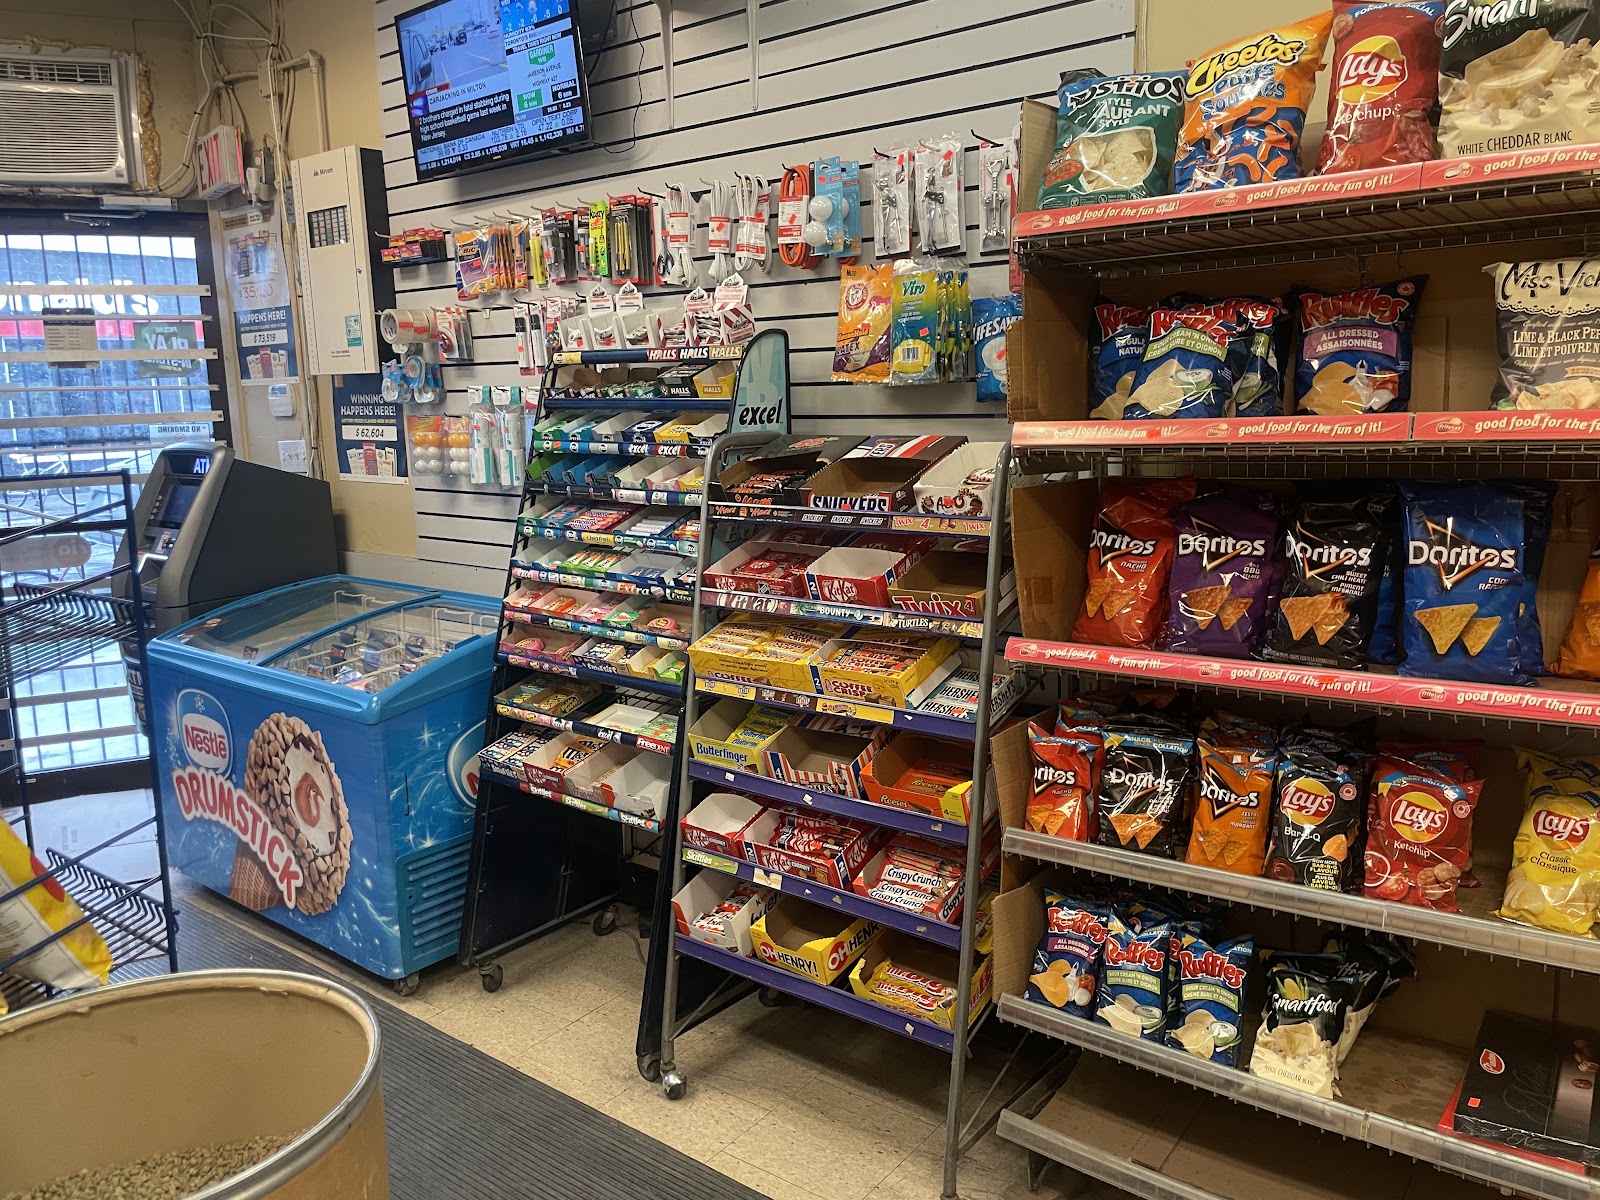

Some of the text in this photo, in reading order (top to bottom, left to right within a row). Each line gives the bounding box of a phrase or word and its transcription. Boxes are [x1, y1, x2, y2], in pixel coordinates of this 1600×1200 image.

[1185, 34, 1306, 98] Cheetos
[1339, 54, 1403, 87] Lay's
[430, 82, 486, 104] CARJACKING MILTON
[552, 80, 576, 92] NORMAL
[523, 91, 535, 100] NOW
[423, 93, 510, 124] brothers charged stabbing during
[430, 112, 479, 132] school basketball game
[464, 134, 485, 144] CANADA
[1458, 130, 1573, 155] WHITE CHEDDAR BLANC
[198, 133, 221, 191] EXIT
[1484, 150, 1598, 175] good food for the
[1247, 173, 1394, 204] good food for the fun of it!
[1059, 206, 1153, 226] good food for the fun
[1501, 263, 1556, 299] Miss
[239, 309, 286, 325] HAPPENS HERE!
[1300, 287, 1409, 332] Ruffles
[1170, 330, 1193, 341] CREAM
[1321, 329, 1379, 341] ALL DRESSED
[1513, 328, 1581, 344] LIME BLACK
[649, 346, 741, 360] HALLS HALLS HALLS
[1169, 339, 1223, 357] SURE OIGNON
[1315, 337, 1383, 352] ASSAISONNÉES
[1515, 342, 1591, 358] LIME ET POIVRE
[351, 394, 384, 404] WINNING
[341, 406, 396, 416] HAPPENS HERE!
[738, 398, 782, 427] excel
[1054, 424, 1147, 440] good food for the fun
[1238, 421, 1383, 438] good food for the fun of it!
[1475, 415, 1588, 434] good food for the
[361, 428, 384, 439] 62,604
[628, 443, 681, 456] excel excel
[715, 506, 771, 516] Mars Mars
[802, 513, 882, 525] SNICKERS SNICKERS SNICKERS
[1090, 529, 1156, 556] Doritos
[1178, 533, 1266, 556] Doritos
[1285, 535, 1371, 566] Doritos
[1408, 540, 1516, 569] Doritos
[617, 582, 649, 596] Extra
[671, 592, 692, 601] Extra
[822, 580, 857, 597] KitKat
[820, 606, 850, 618] BOUNTY
[964, 597, 974, 611] 4
[898, 616, 929, 628] TURTLES
[1045, 648, 1088, 660] good food
[1119, 655, 1161, 670] fun of it!
[1230, 666, 1319, 687] good food for the
[832, 680, 873, 693] COFFEE
[834, 687, 866, 698] CRISP
[1343, 680, 1371, 694] of it!
[1457, 691, 1488, 704] good
[1490, 691, 1520, 705] food
[1522, 694, 1543, 707] for
[1545, 698, 1569, 711] the
[1569, 703, 1592, 717] fun
[185, 725, 227, 760] Nestlé
[696, 742, 748, 763] Butterfinger
[530, 786, 552, 798] Skittles
[1201, 779, 1258, 808] Doritos
[565, 797, 586, 811] Skittles
[1282, 789, 1332, 816] Lay's
[621, 814, 646, 828] Skittles
[1393, 799, 1446, 832] Lay's
[1537, 810, 1588, 841] Lay's
[175, 772, 301, 903] DRUMSTICK
[1393, 839, 1430, 858] Ketchup
[686, 851, 712, 865] Skittles
[761, 851, 792, 872] KitKat
[1530, 856, 1577, 874] Classique
[1539, 851, 1571, 864] Classic
[887, 867, 942, 888] CrispyCrunch
[870, 890, 925, 909] CrispyCrunch
[761, 943, 818, 978] OH HENRY!
[828, 945, 848, 969] OH
[1105, 937, 1165, 972] Ruffles
[1179, 950, 1247, 988] Ruffles
[1119, 973, 1157, 985] CREAM ONION
[1140, 981, 1158, 992] OIGNON
[1185, 985, 1213, 995] SOUR CREAM
[1199, 993, 1210, 1001] SURE
[1277, 1068, 1302, 1083] CHEDDAR
